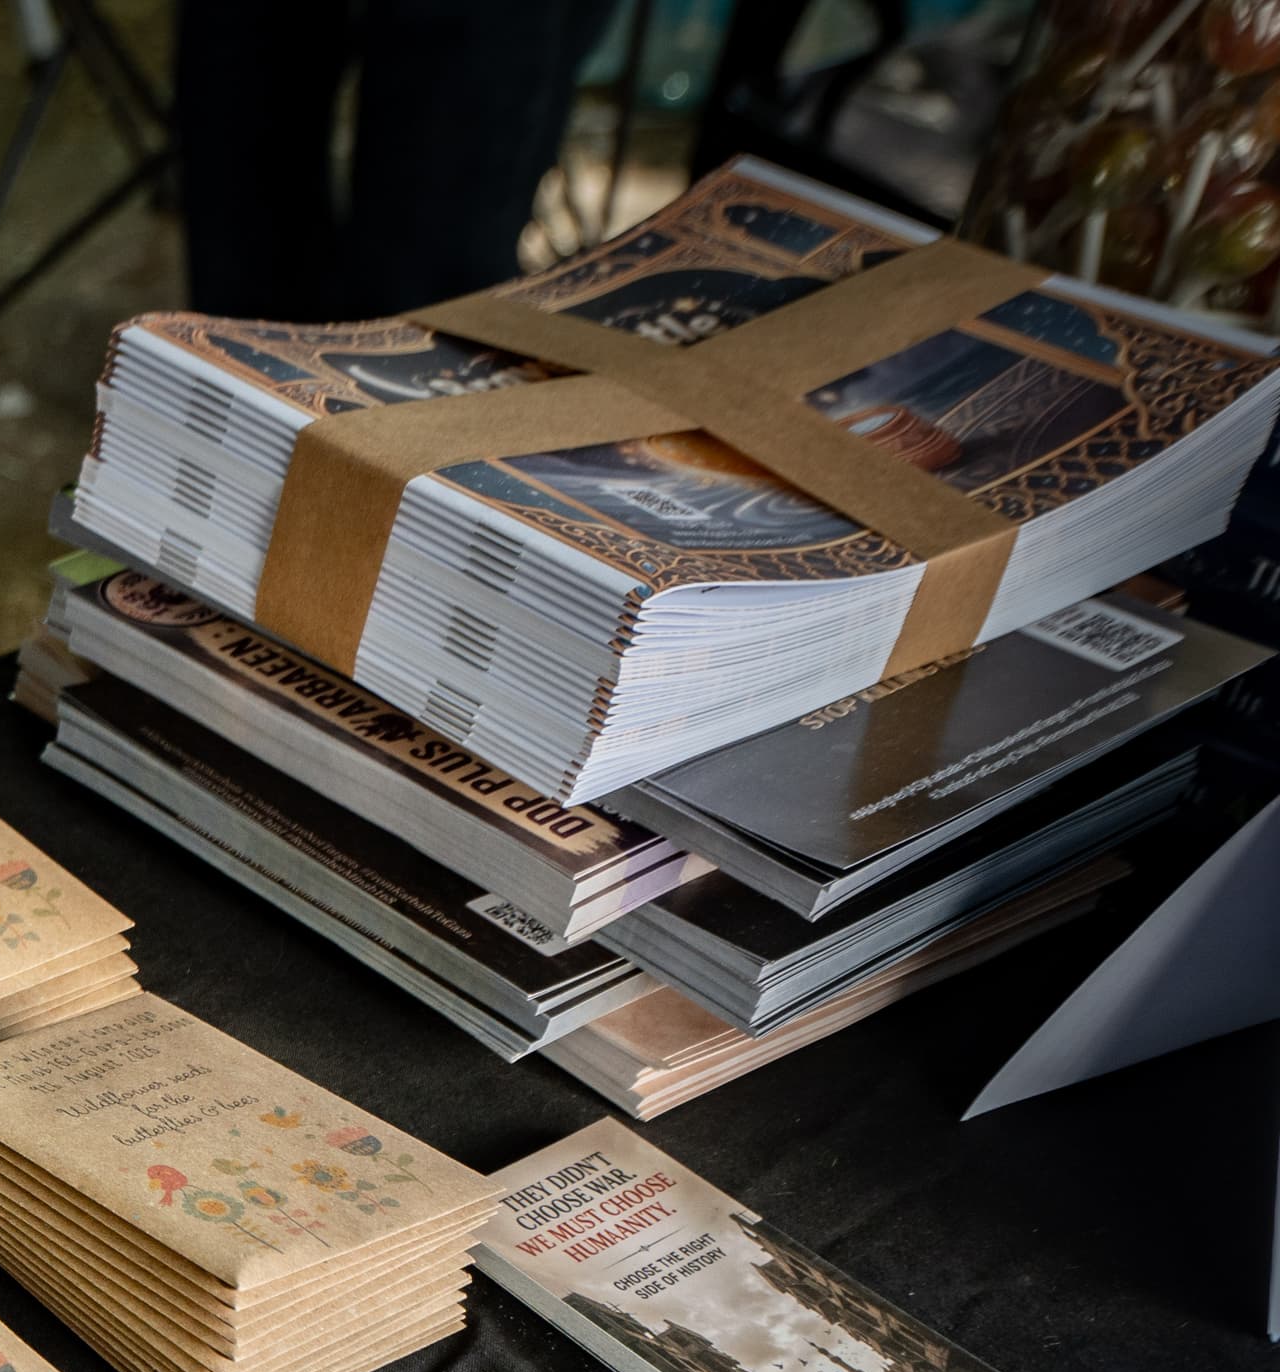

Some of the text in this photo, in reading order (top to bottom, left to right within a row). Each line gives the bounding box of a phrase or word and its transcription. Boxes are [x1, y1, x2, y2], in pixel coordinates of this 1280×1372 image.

[409, 738, 515, 796] PLUS
[504, 784, 595, 840] DDP
[56, 1064, 213, 1117] Wildflower seeds
[497, 1151, 612, 1213] THEY DIDN'T
[516, 1168, 638, 1231] CHOOSE WAR.
[516, 1172, 677, 1257] WE MUST CHOOSE
[562, 1201, 677, 1263] HUMAANITY.
[613, 1232, 716, 1292] CHOOSE THE RIGHT
[634, 1246, 727, 1300] SIDE OF HISTORY
